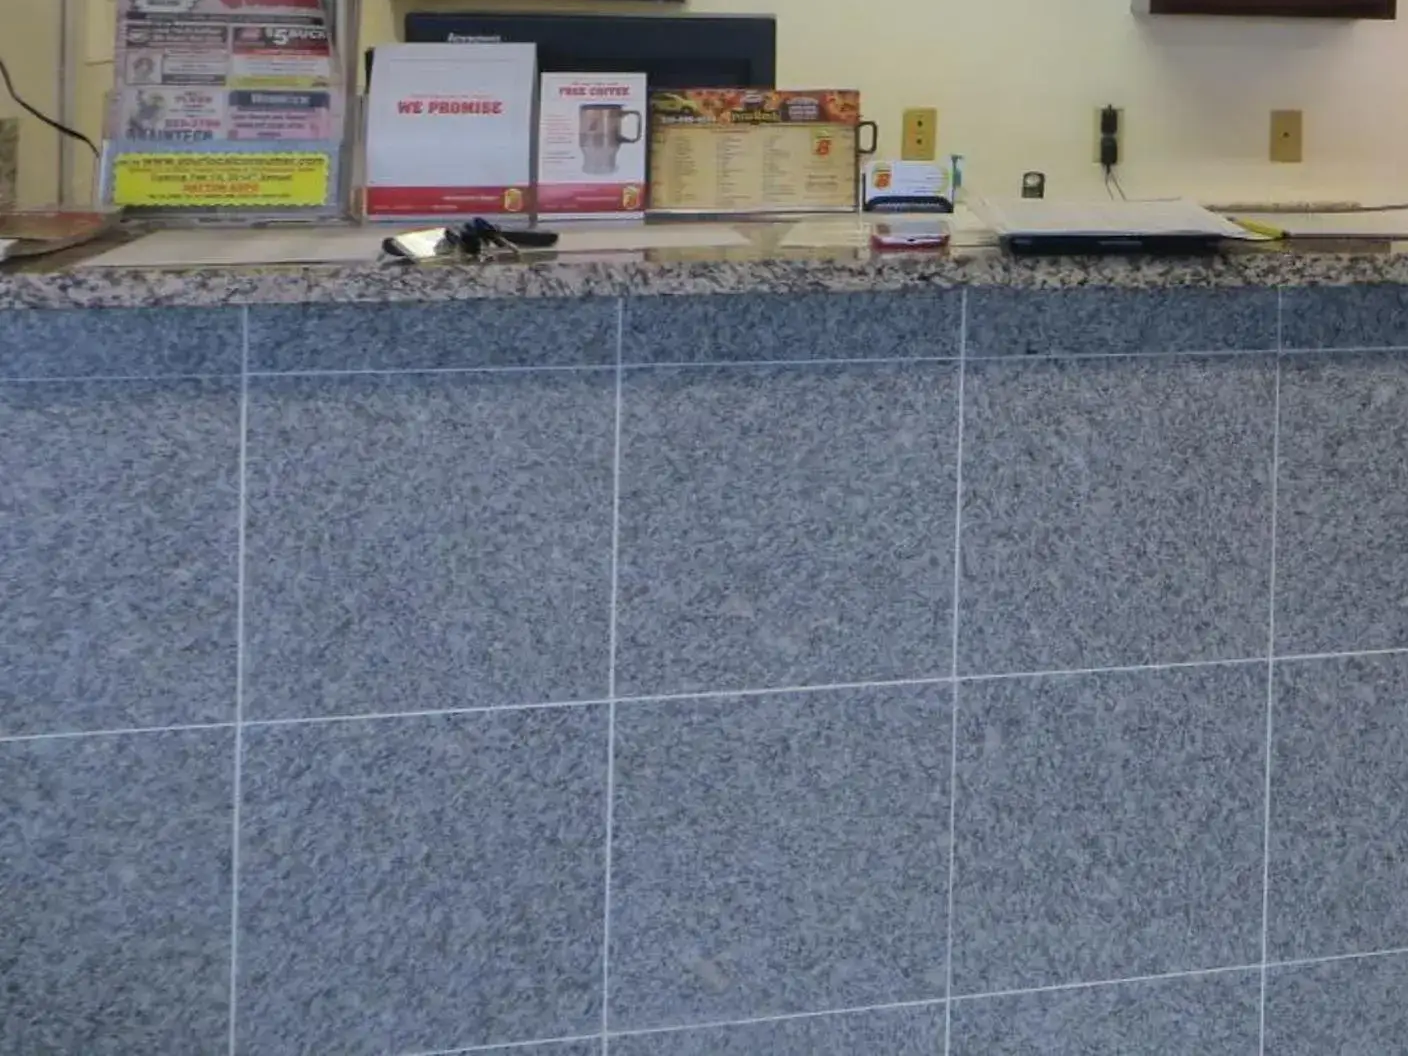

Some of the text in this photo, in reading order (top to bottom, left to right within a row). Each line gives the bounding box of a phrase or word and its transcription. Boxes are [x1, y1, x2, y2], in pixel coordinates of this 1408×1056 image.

[559, 86, 631, 96] FREE COFFEE
[397, 100, 503, 115] WE PROMISE
